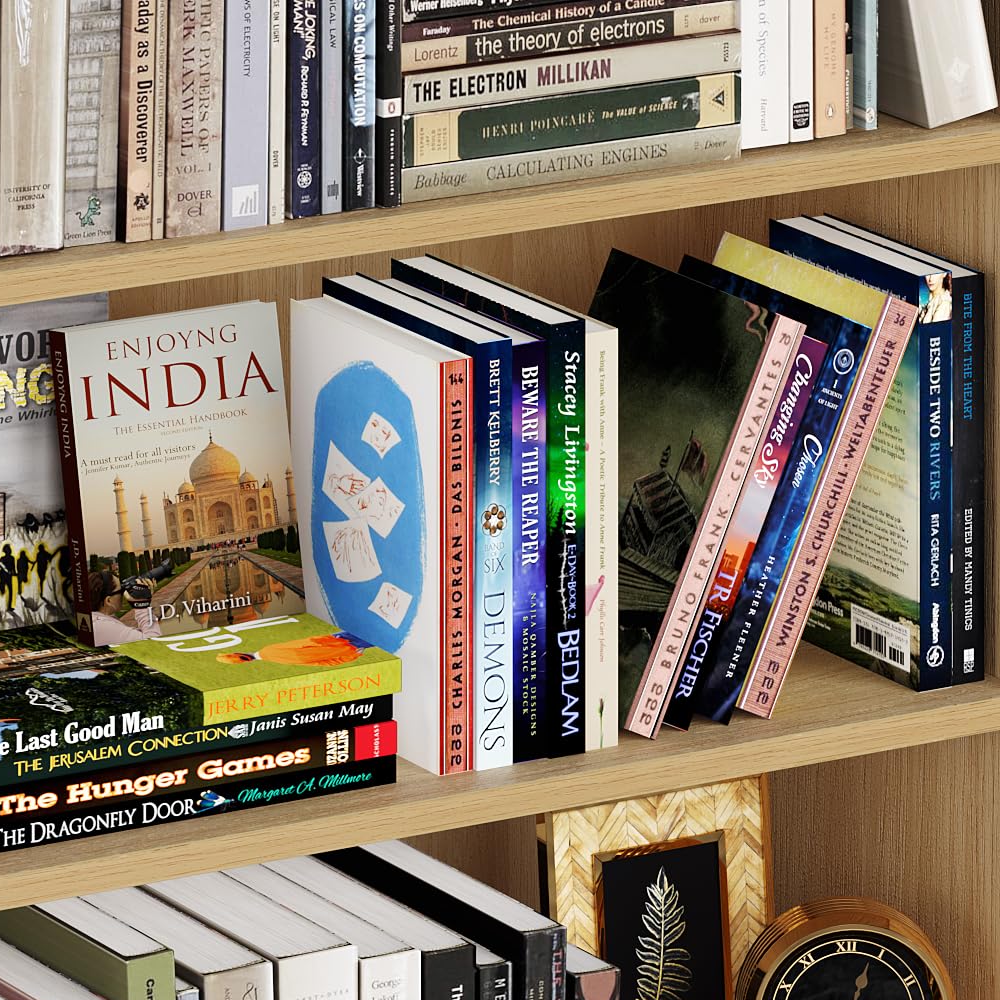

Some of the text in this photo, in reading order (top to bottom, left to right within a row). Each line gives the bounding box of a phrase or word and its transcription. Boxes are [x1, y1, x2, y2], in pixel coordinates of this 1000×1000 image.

[414, 45, 458, 62] Lorentz
[475, 19, 666, 57] the theory of electrons
[353, 13, 366, 127] ON COMPUTATION
[413, 59, 612, 103] THE ELECTRON MILLIKAN
[414, 170, 468, 191] Babbage
[486, 144, 668, 180] CALCULATING ENGINES
[177, 190, 212, 202] DOVER
[779, 332, 791, 346] 70
[894, 313, 906, 326] 36
[107, 324, 238, 361] ENJOYNG
[963, 293, 973, 420] BITE FROM THE HEART
[81, 352, 278, 421] INDIA
[487, 359, 501, 486] BRETT KELBERRY
[731, 359, 782, 482] CERVANTES
[754, 352, 813, 489] Changing Sky
[929, 337, 941, 502] BESIDE TWO RIVERS
[81, 443, 196, 467] A must read for all visitors
[557, 351, 580, 535] Stacey Livingston
[521, 366, 539, 567] BEWARE THE REAPER
[209, 674, 382, 718] JERRY PETERSON
[558, 629, 580, 737] BEDLAM
[15, 728, 58, 753] Last
[63, 719, 118, 743] Good
[121, 713, 164, 732] Man
[249, 700, 374, 736] Janis Susan May
[66, 772, 187, 804] Hunger
[195, 747, 311, 778] Games
[836, 942, 857, 952] XII
